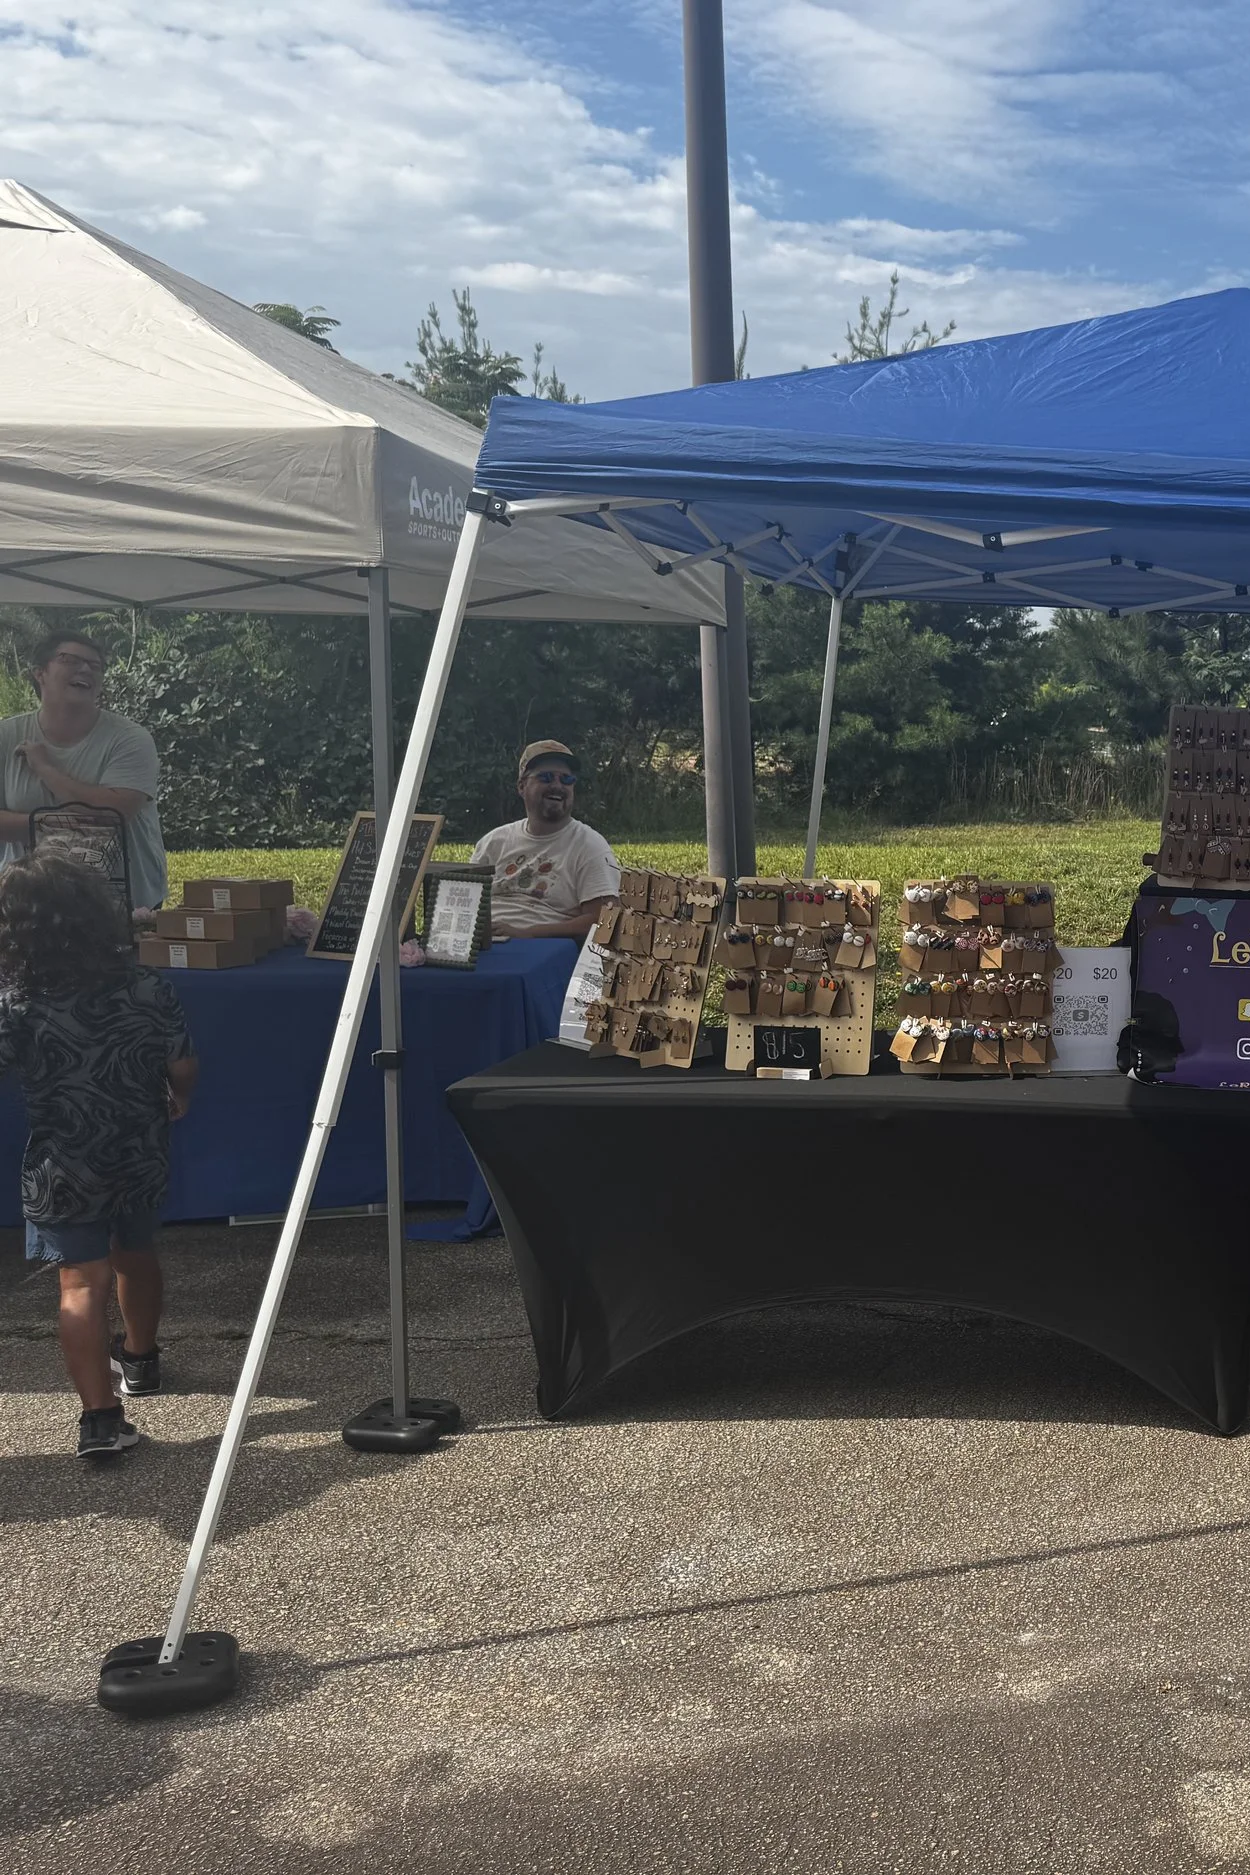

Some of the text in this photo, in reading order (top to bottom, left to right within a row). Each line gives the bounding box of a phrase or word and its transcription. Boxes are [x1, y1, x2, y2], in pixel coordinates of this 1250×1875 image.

[409, 475, 466, 528] Acade
[445, 896, 473, 908] TO PAY
[1053, 967, 1118, 980] 20 $20
